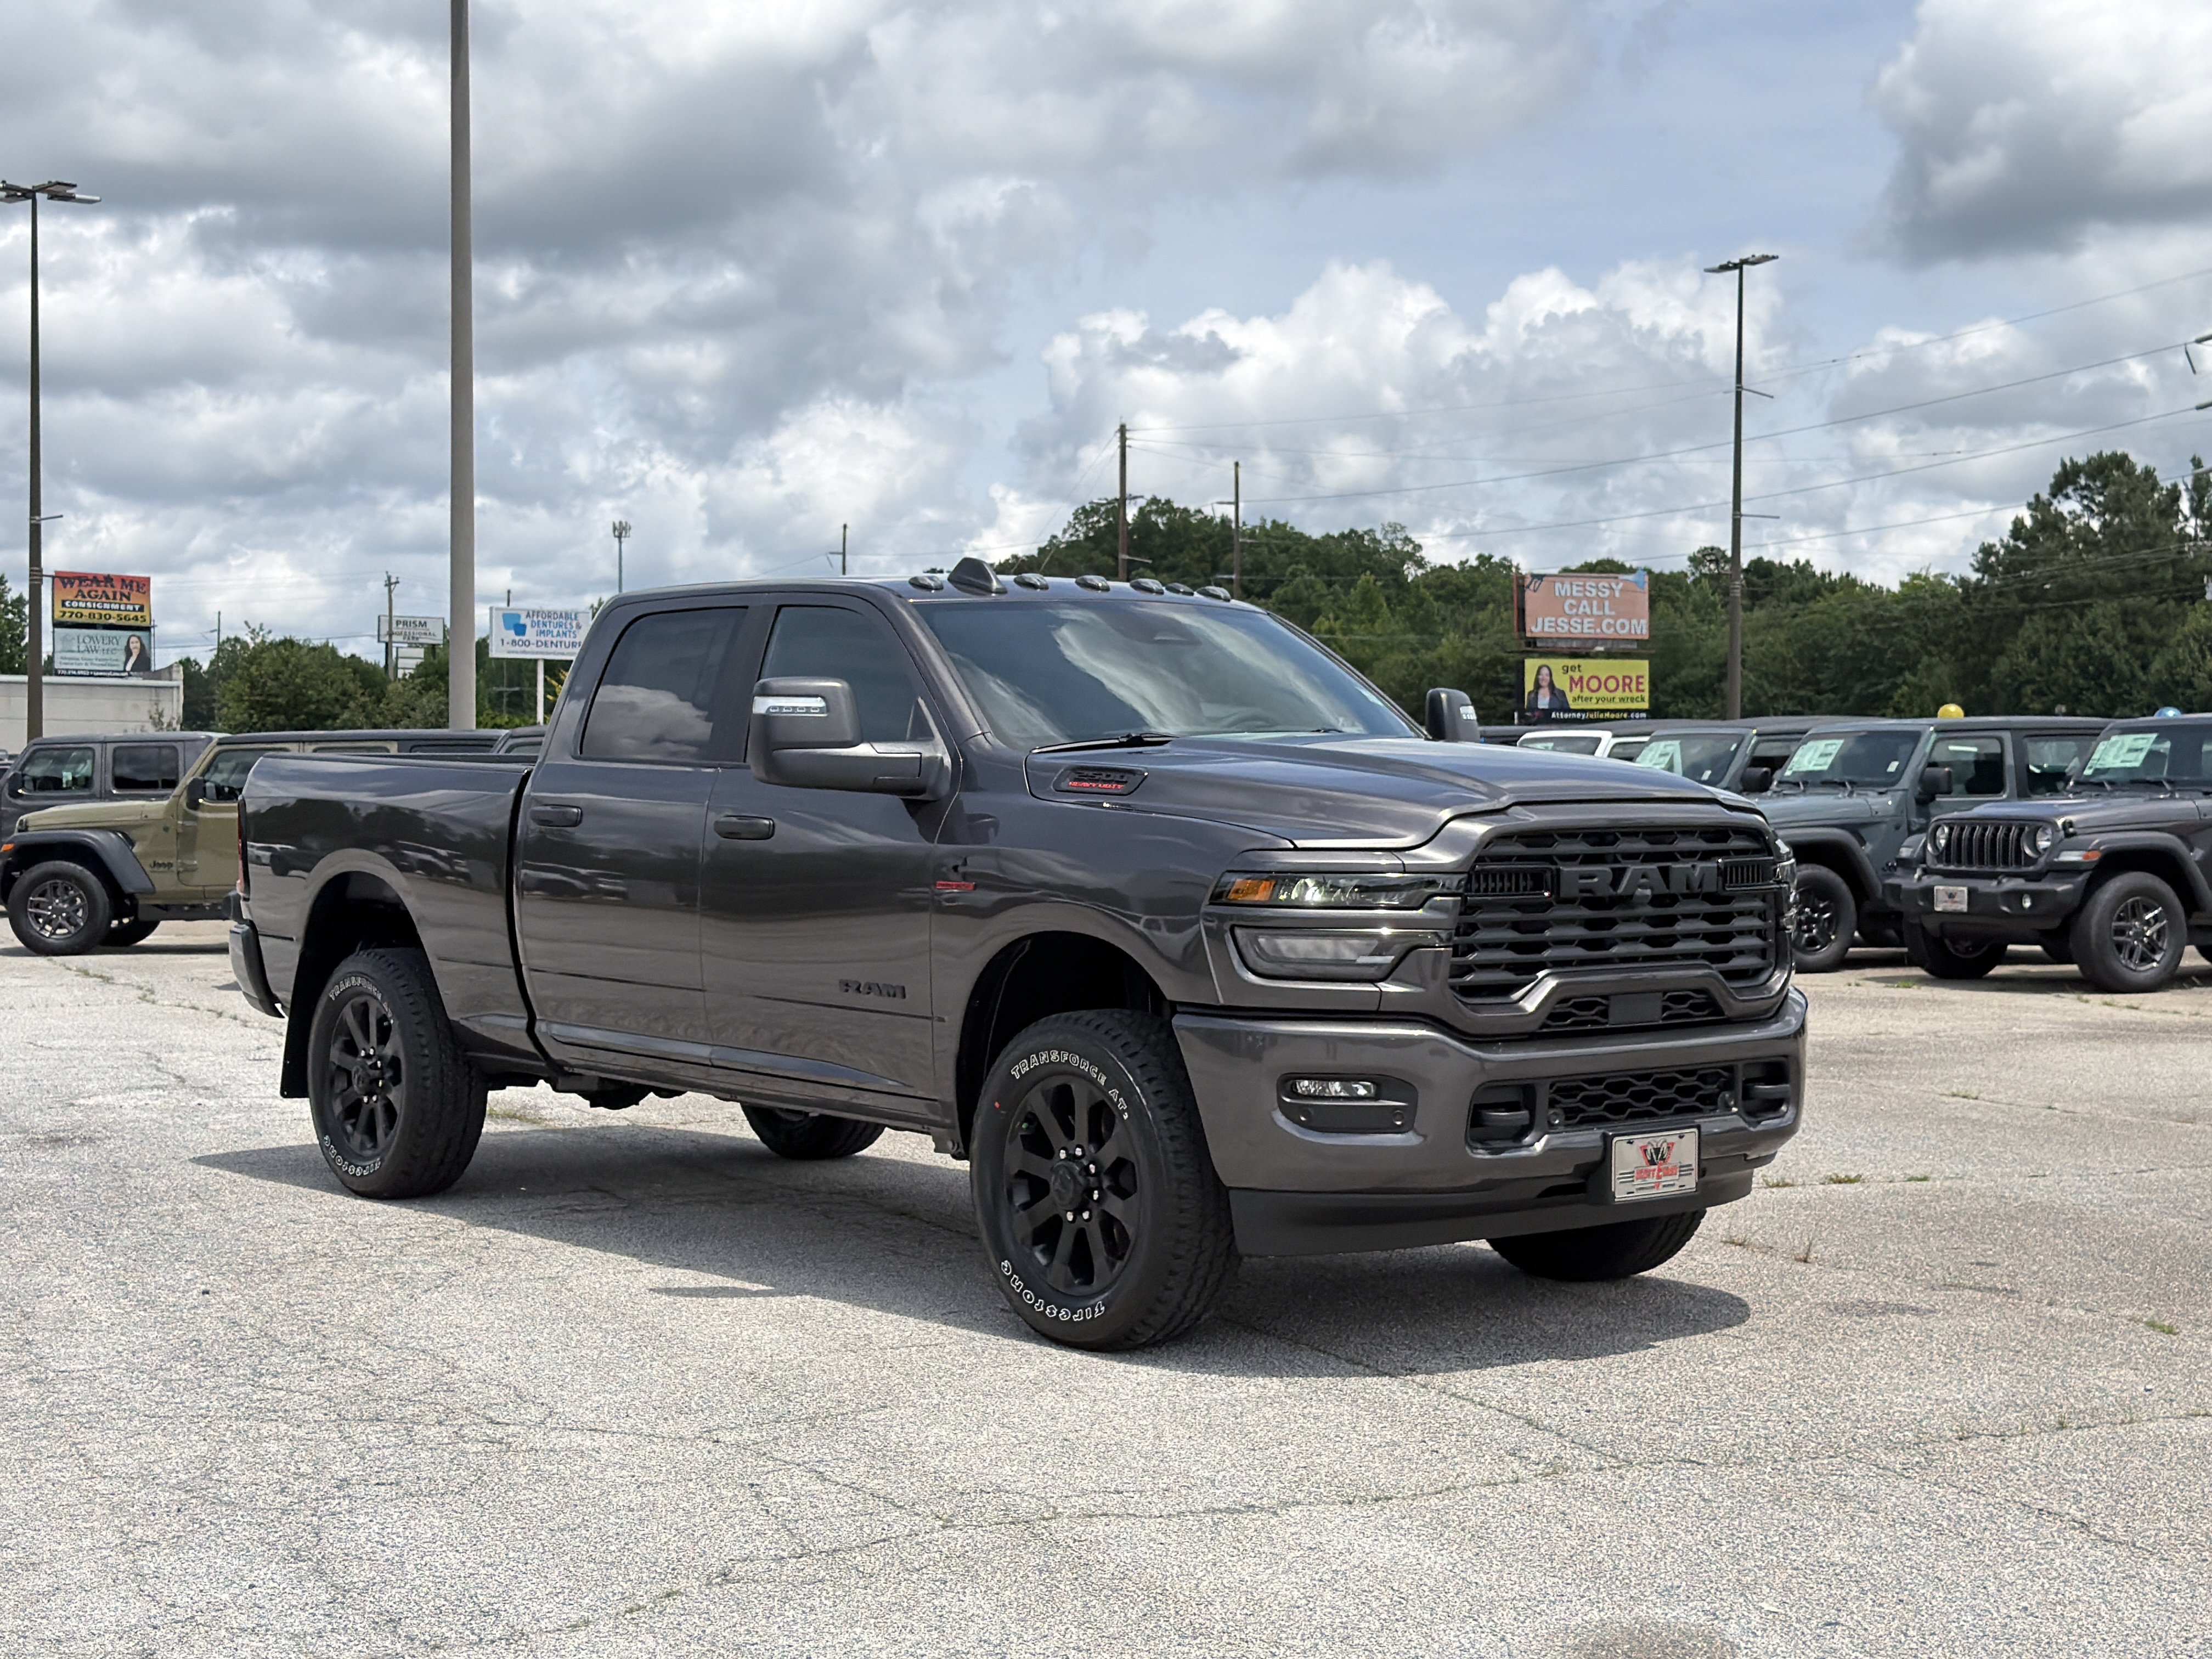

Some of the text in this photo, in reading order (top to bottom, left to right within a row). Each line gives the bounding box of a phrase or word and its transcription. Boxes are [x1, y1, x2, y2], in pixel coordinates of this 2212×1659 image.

[59, 575, 146, 594] WEAR ME
[1554, 581, 1623, 598] MESSY
[74, 589, 131, 601] AGAIN
[65, 600, 141, 611] CONSIGNMENT
[1564, 599, 1616, 616] CALL
[59, 611, 147, 623] 770-830-5645
[526, 611, 579, 620] AFFORDABLE
[531, 620, 582, 630] DENTURES &
[1531, 617, 1646, 635] JESSE.COM
[77, 634, 122, 646] LOWERY
[536, 630, 577, 639] IMPLANTS
[77, 645, 100, 654] LAW
[1562, 664, 1582, 674] get
[1569, 675, 1645, 693] MOORE
[1572, 694, 1645, 704] after your wreck
[1560, 863, 1718, 898] RAM
[838, 979, 906, 1000] RAM
[1011, 1050, 1107, 1086] TRANSFORCE
